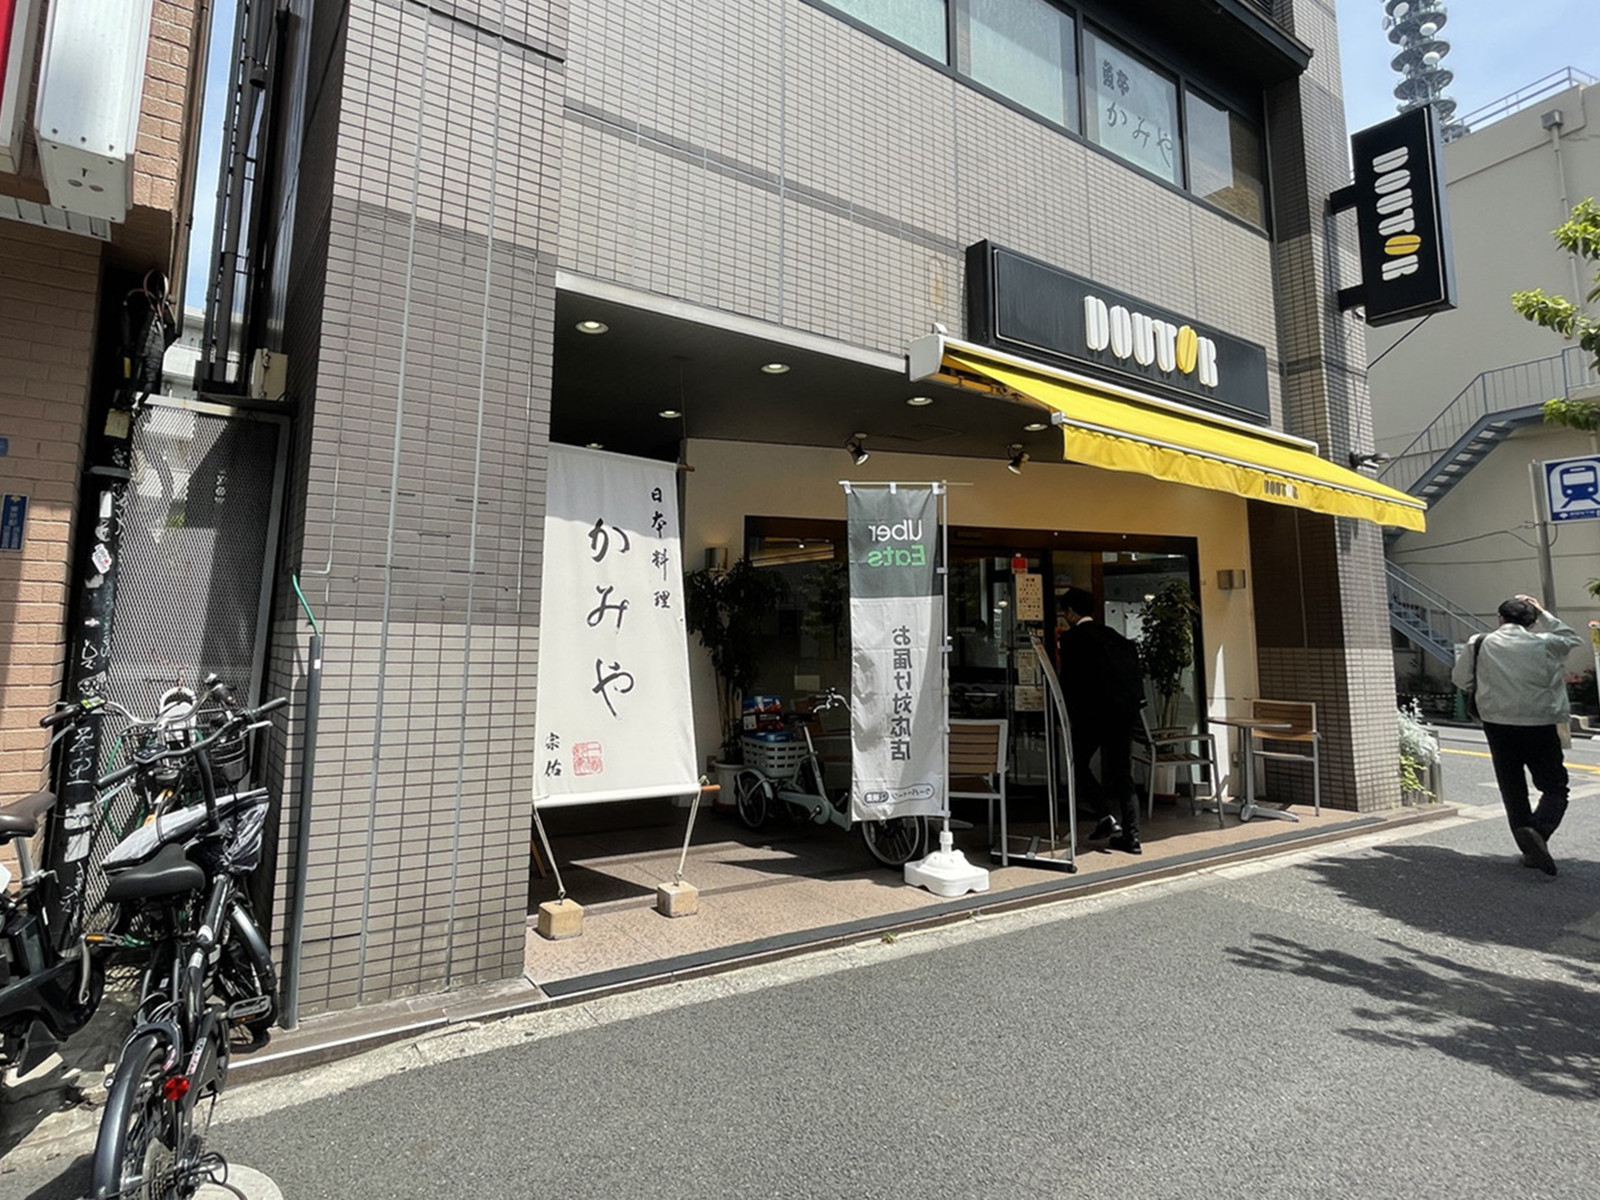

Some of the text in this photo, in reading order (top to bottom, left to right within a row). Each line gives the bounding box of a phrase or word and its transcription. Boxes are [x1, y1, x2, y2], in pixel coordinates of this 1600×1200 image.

[1107, 102, 1173, 168] かみや
[1372, 146, 1421, 281] DOUTOR
[1084, 295, 1218, 388] DOUTOR
[1263, 479, 1299, 500] DOUTOR
[651, 487, 671, 609] 日本料理
[587, 518, 635, 721] かみや
